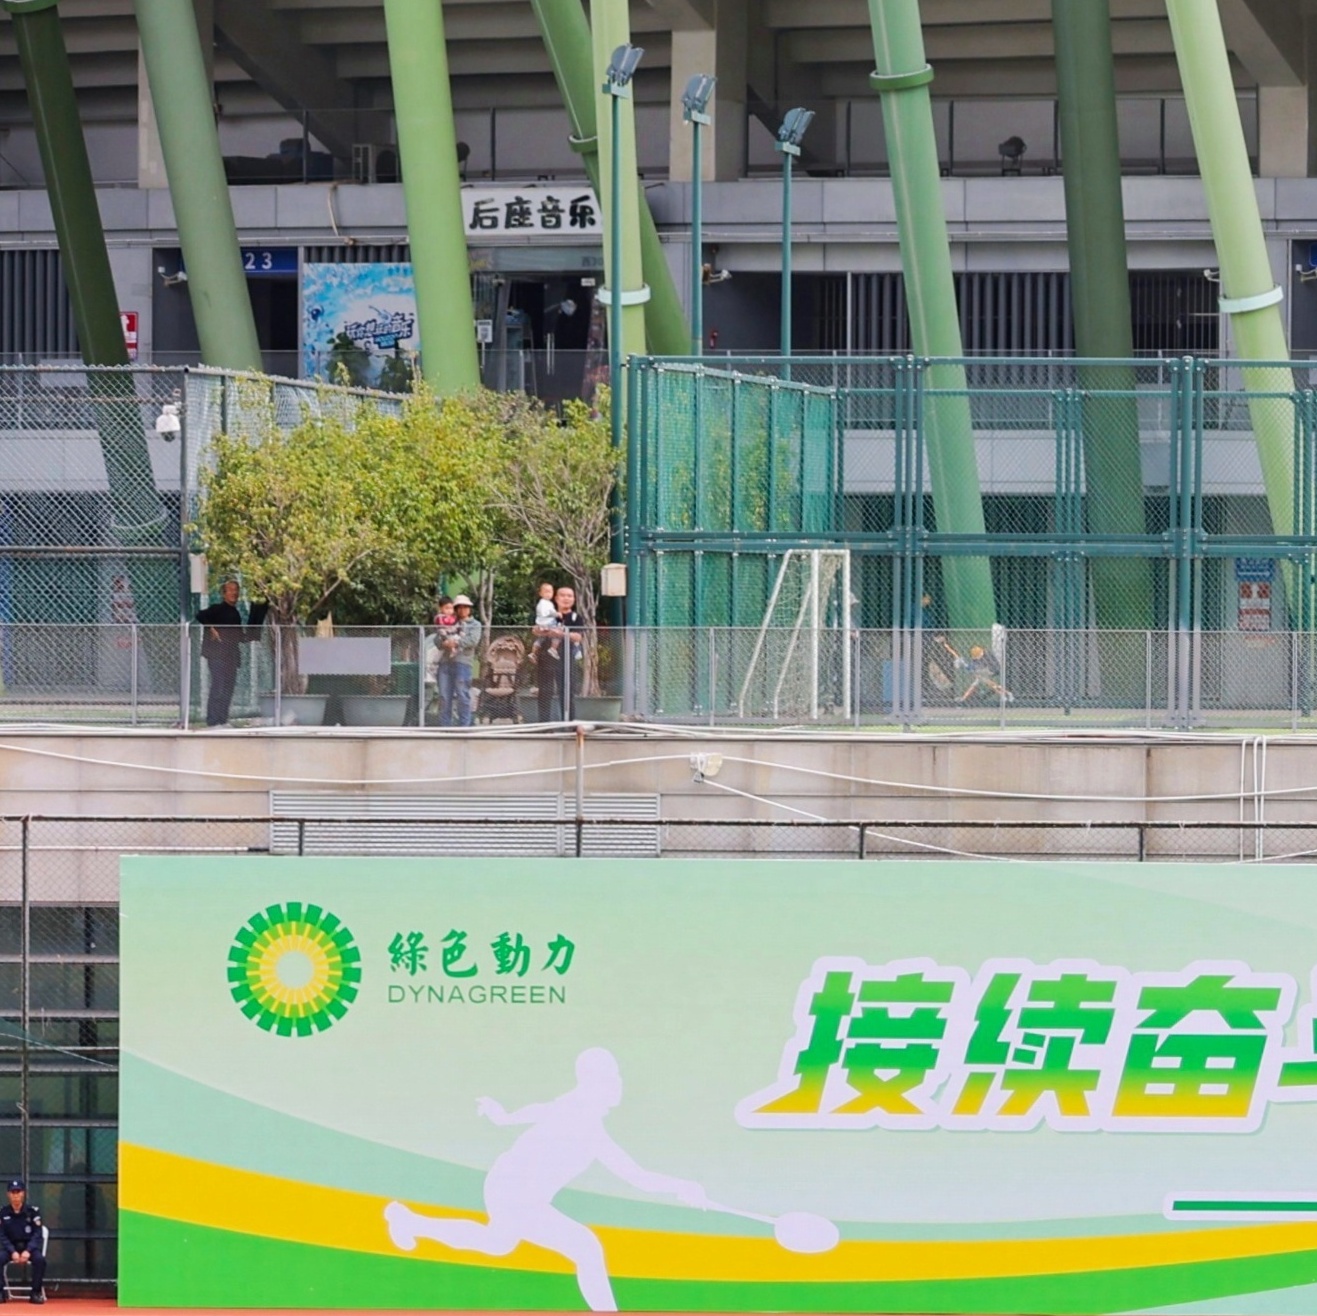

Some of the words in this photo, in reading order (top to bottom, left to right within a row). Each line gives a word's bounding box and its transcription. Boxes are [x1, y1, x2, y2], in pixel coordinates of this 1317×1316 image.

[469, 195, 596, 230] 后座音乐
[388, 985, 566, 1005] DYNAGREEN
